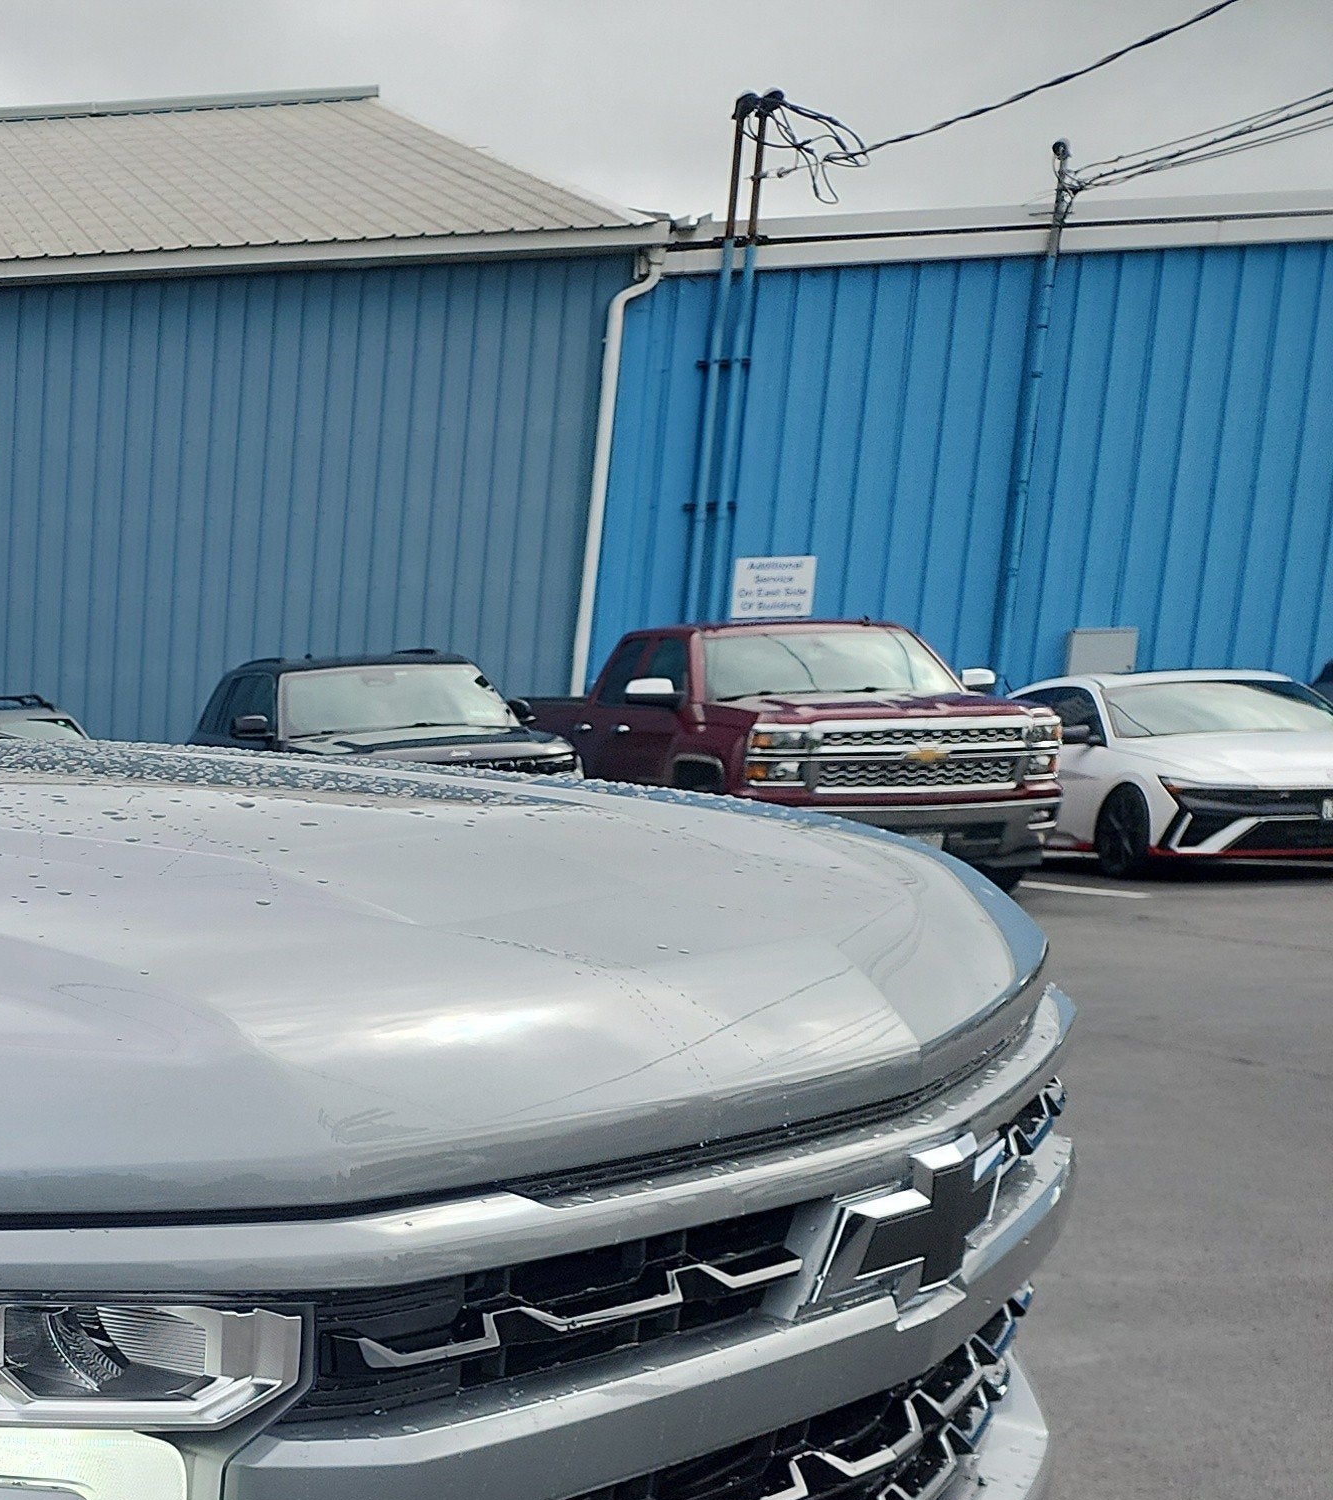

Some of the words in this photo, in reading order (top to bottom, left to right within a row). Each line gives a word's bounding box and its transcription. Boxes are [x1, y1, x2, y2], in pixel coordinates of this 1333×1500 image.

[747, 561, 804, 571] Additional
[754, 575, 794, 584] Service
[738, 588, 752, 598] On
[757, 601, 802, 612] Building
